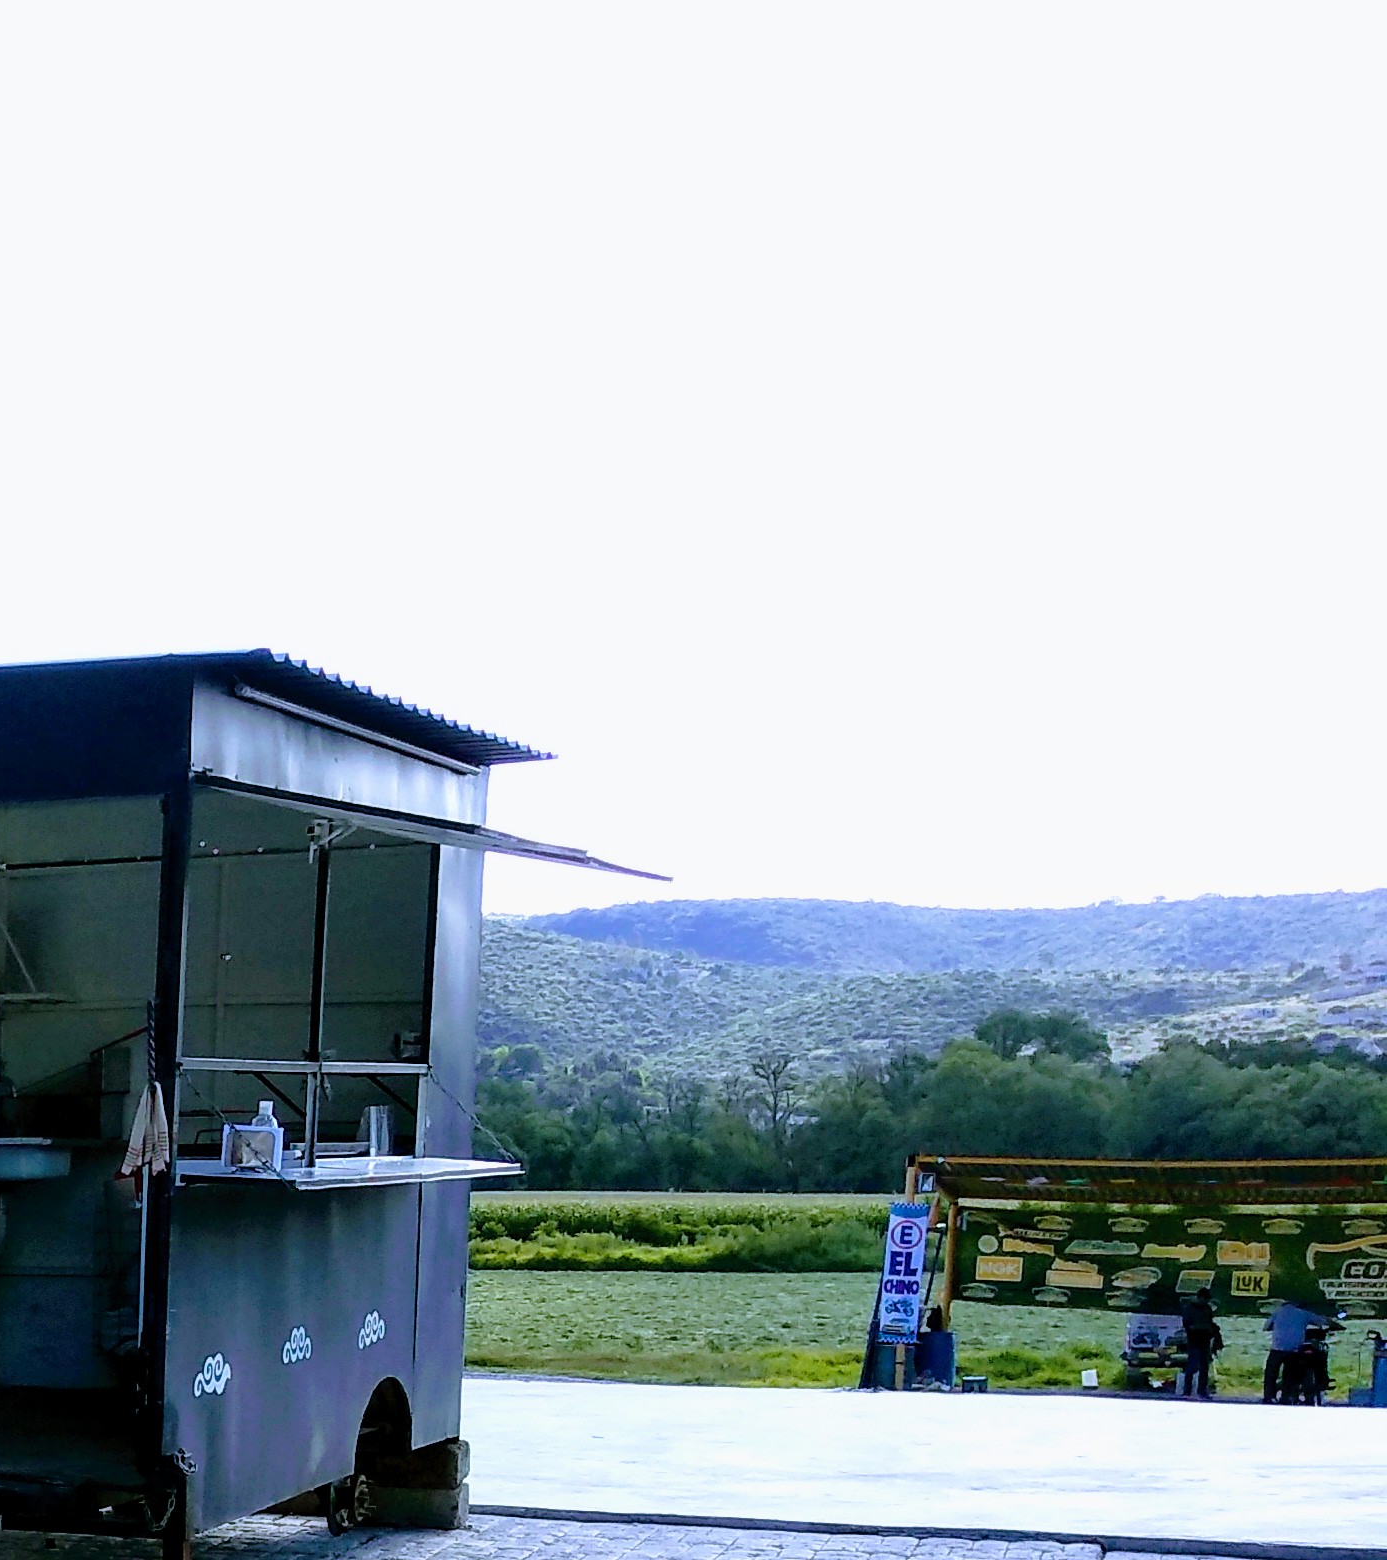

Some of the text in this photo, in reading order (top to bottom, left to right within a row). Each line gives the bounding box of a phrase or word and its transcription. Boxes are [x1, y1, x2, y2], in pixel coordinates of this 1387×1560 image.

[899, 1225, 913, 1245] E
[888, 1250, 918, 1276] EL
[883, 1279, 920, 1295] CHINO
